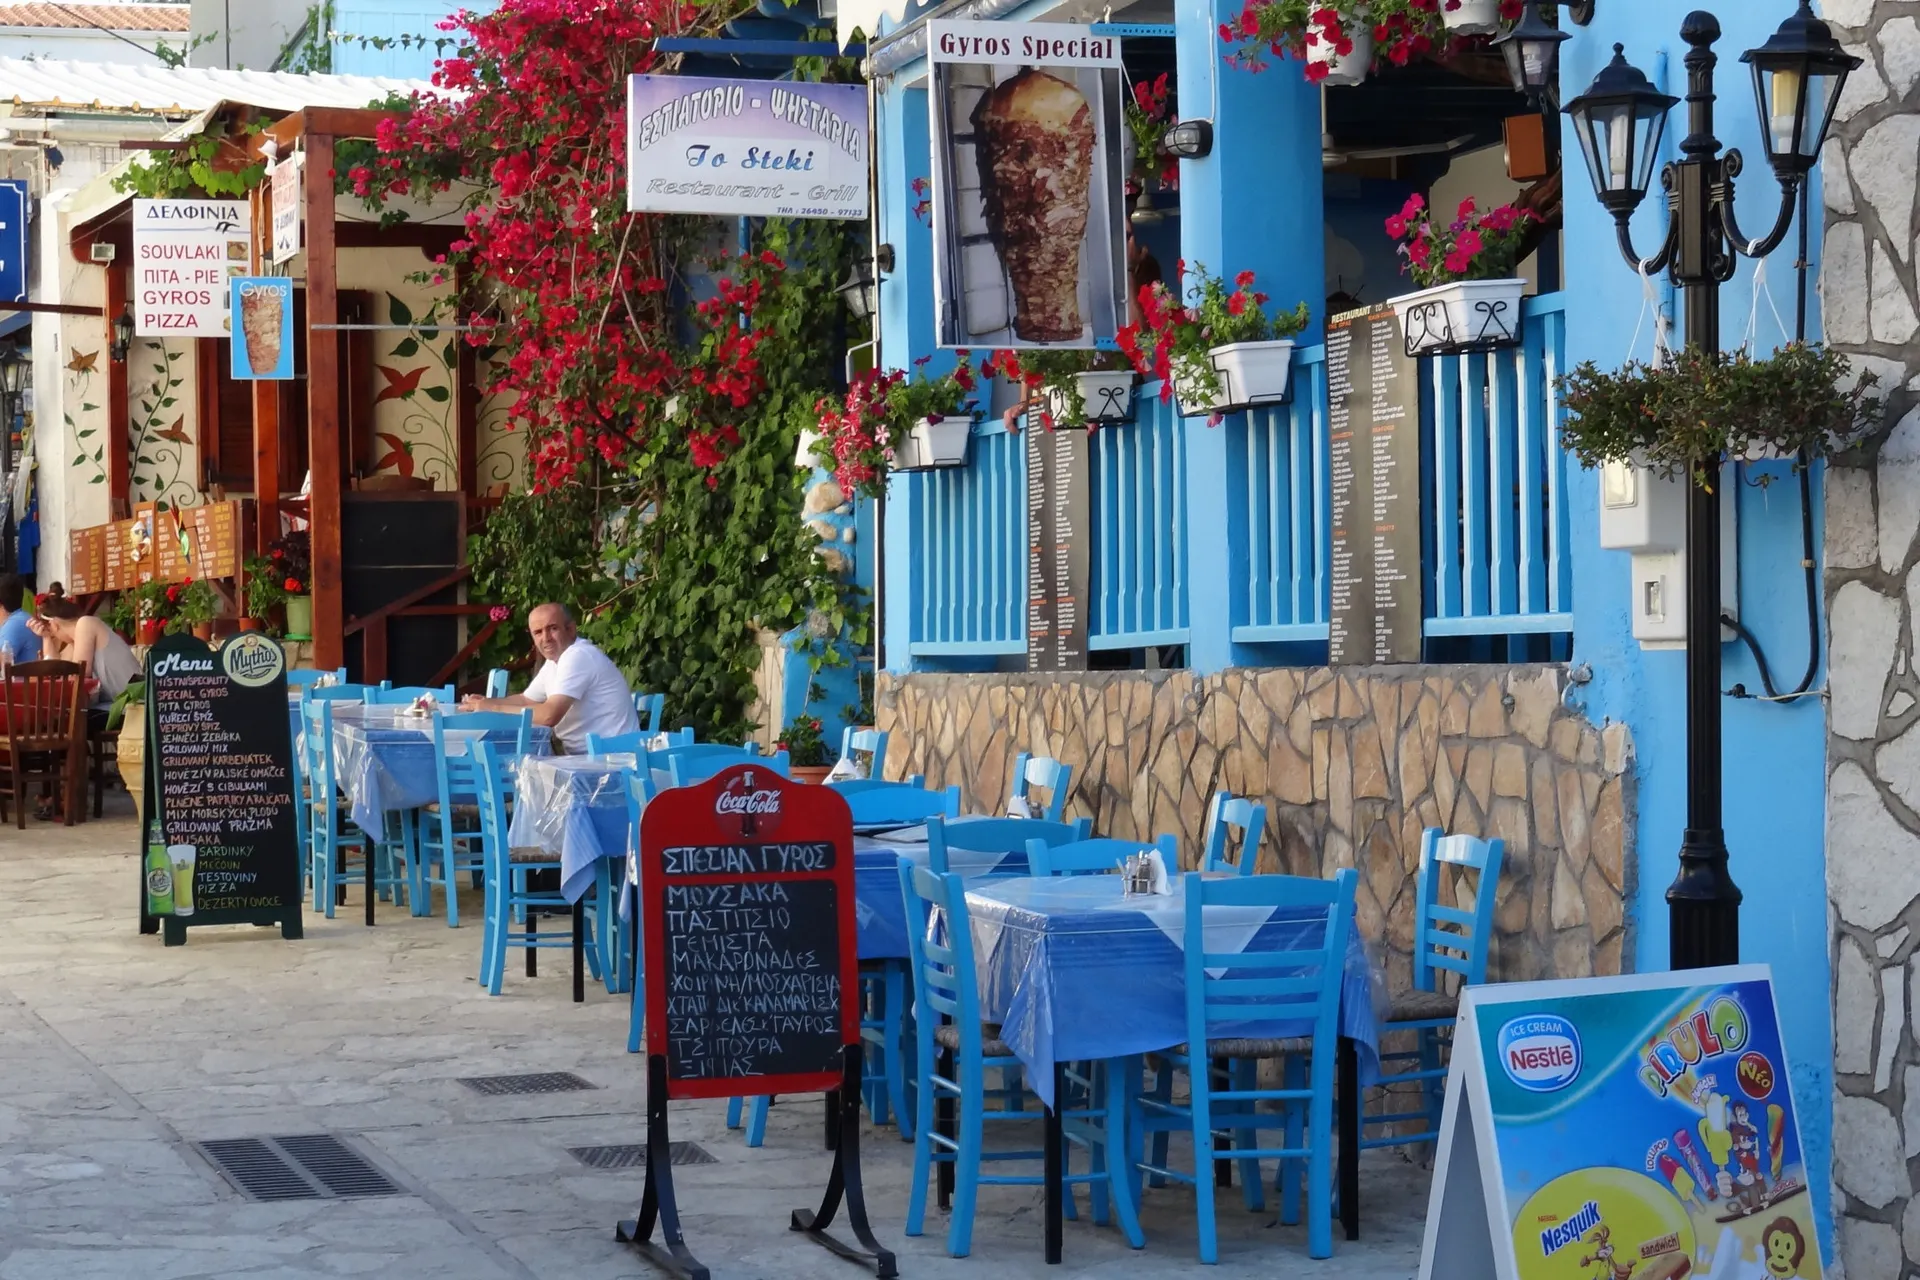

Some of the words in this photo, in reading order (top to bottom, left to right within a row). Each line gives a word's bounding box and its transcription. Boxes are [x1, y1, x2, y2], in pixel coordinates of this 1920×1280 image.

[940, 33, 1010, 57] Gyros
[1023, 36, 1112, 59] Special
[639, 85, 744, 150] ΕΣΤΙΑΤΟΡΙΟ
[770, 87, 861, 162] ΨΗΣΤΑΡΙΑ
[686, 144, 728, 168] To
[741, 147, 814, 171] Steki
[646, 178, 785, 200] Restaurant
[808, 185, 859, 202] Grill
[147, 205, 239, 220] ΔΕΛΦΙΝΙΑ
[141, 245, 220, 260] SOUVLAKI
[195, 270, 219, 284] PIE
[143, 290, 211, 305] GYROS
[239, 281, 288, 299] Gyros
[145, 314, 198, 328] PIZZA
[1331, 305, 1371, 324] RESTAURANT
[154, 653, 213, 677] Menu
[230, 648, 277, 674] Mythos
[200, 687, 228, 698] GYROS
[158, 702, 180, 712] PITA
[213, 744, 228, 753] MIX
[716, 790, 781, 814] Coca-Cola
[199, 845, 254, 857] SARDINKY
[761, 844, 829, 872] ΓΥΡΟΣ
[668, 881, 789, 909] ΜΟΥΣΑΚΑ
[666, 906, 790, 933] ΠΑΣΤΙΤΣΙΟ
[1510, 1024, 1526, 1037] ICE
[1526, 1022, 1562, 1033] CREAM
[1510, 1045, 1573, 1070] Nestlé
[1639, 996, 1749, 1098] PIRULO
[1541, 1201, 1601, 1256] Nesquik
[1640, 1234, 1677, 1255] sandwich
